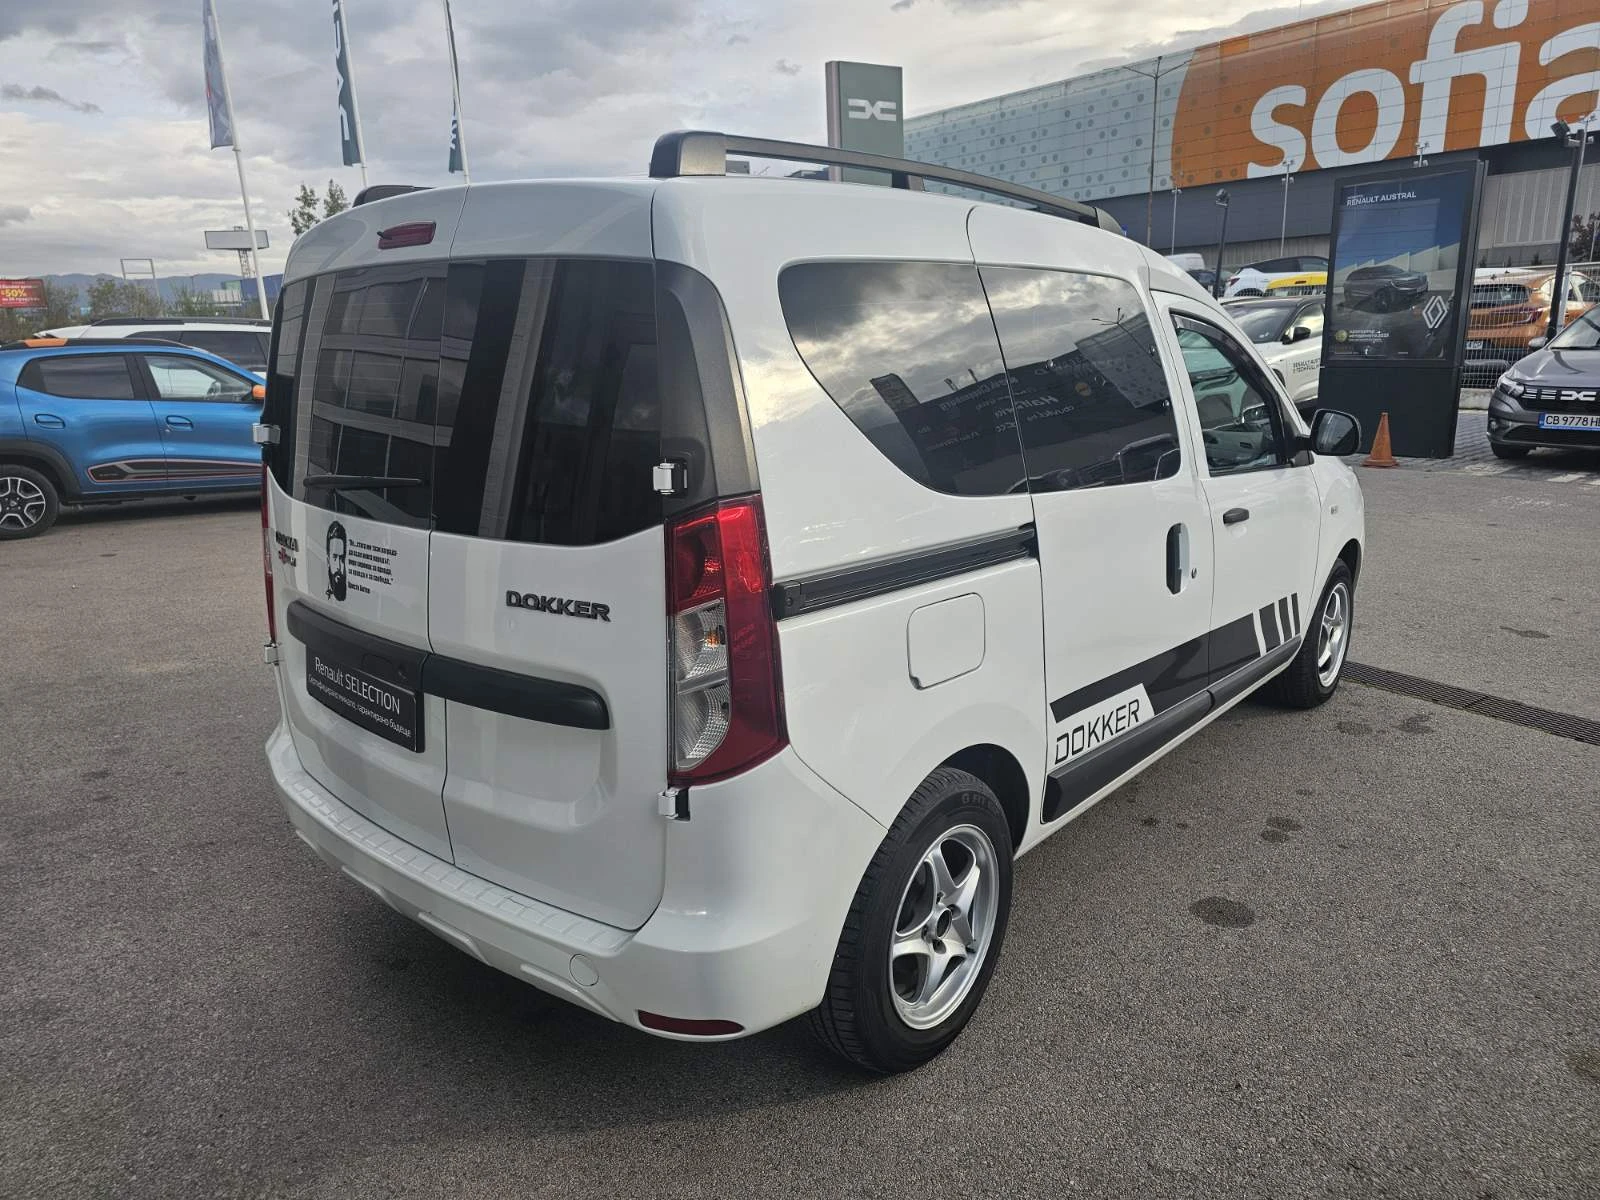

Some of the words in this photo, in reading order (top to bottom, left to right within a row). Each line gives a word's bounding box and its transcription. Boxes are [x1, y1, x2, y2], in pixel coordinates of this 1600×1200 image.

[1347, 195, 1380, 206] RENAULT
[1380, 192, 1416, 202] AUSTRAL
[1546, 416, 1560, 425] CB
[1563, 417, 1588, 426] 9778
[506, 590, 611, 622] DOKKER
[315, 656, 344, 686] Renault
[345, 674, 400, 715] SELECTION
[1054, 699, 1140, 765] DOKKER
